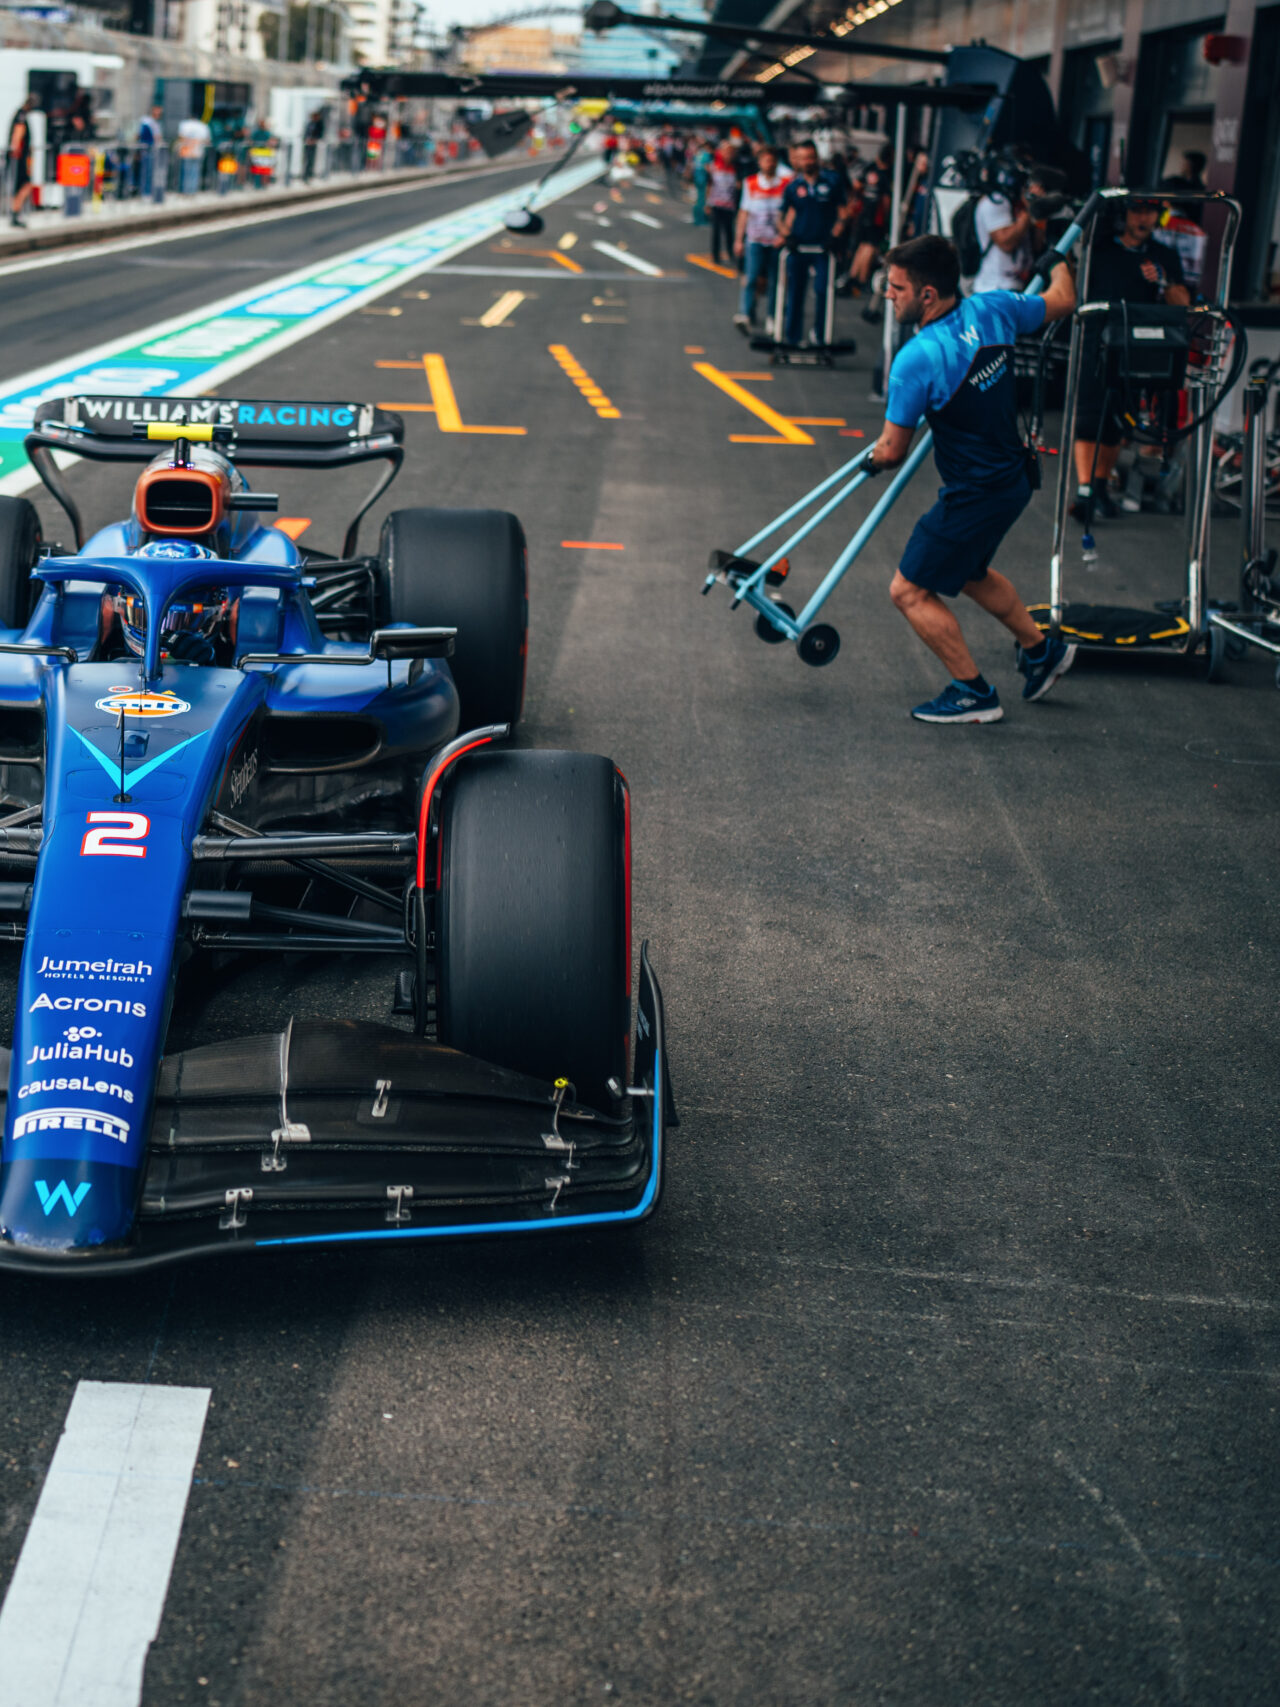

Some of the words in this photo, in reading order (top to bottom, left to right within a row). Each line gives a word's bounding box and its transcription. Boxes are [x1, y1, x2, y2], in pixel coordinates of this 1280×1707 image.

[237, 404, 356, 427] RACING
[80, 811, 151, 858] 2
[36, 956, 153, 976] Jumeirah
[44, 972, 85, 980] HOTELS
[99, 974, 145, 983] RESORTS
[29, 993, 147, 1018] Acronis
[26, 1042, 134, 1068] JuliaHub
[18, 1076, 134, 1104] causaLens
[13, 1107, 130, 1144] PIRELLI
